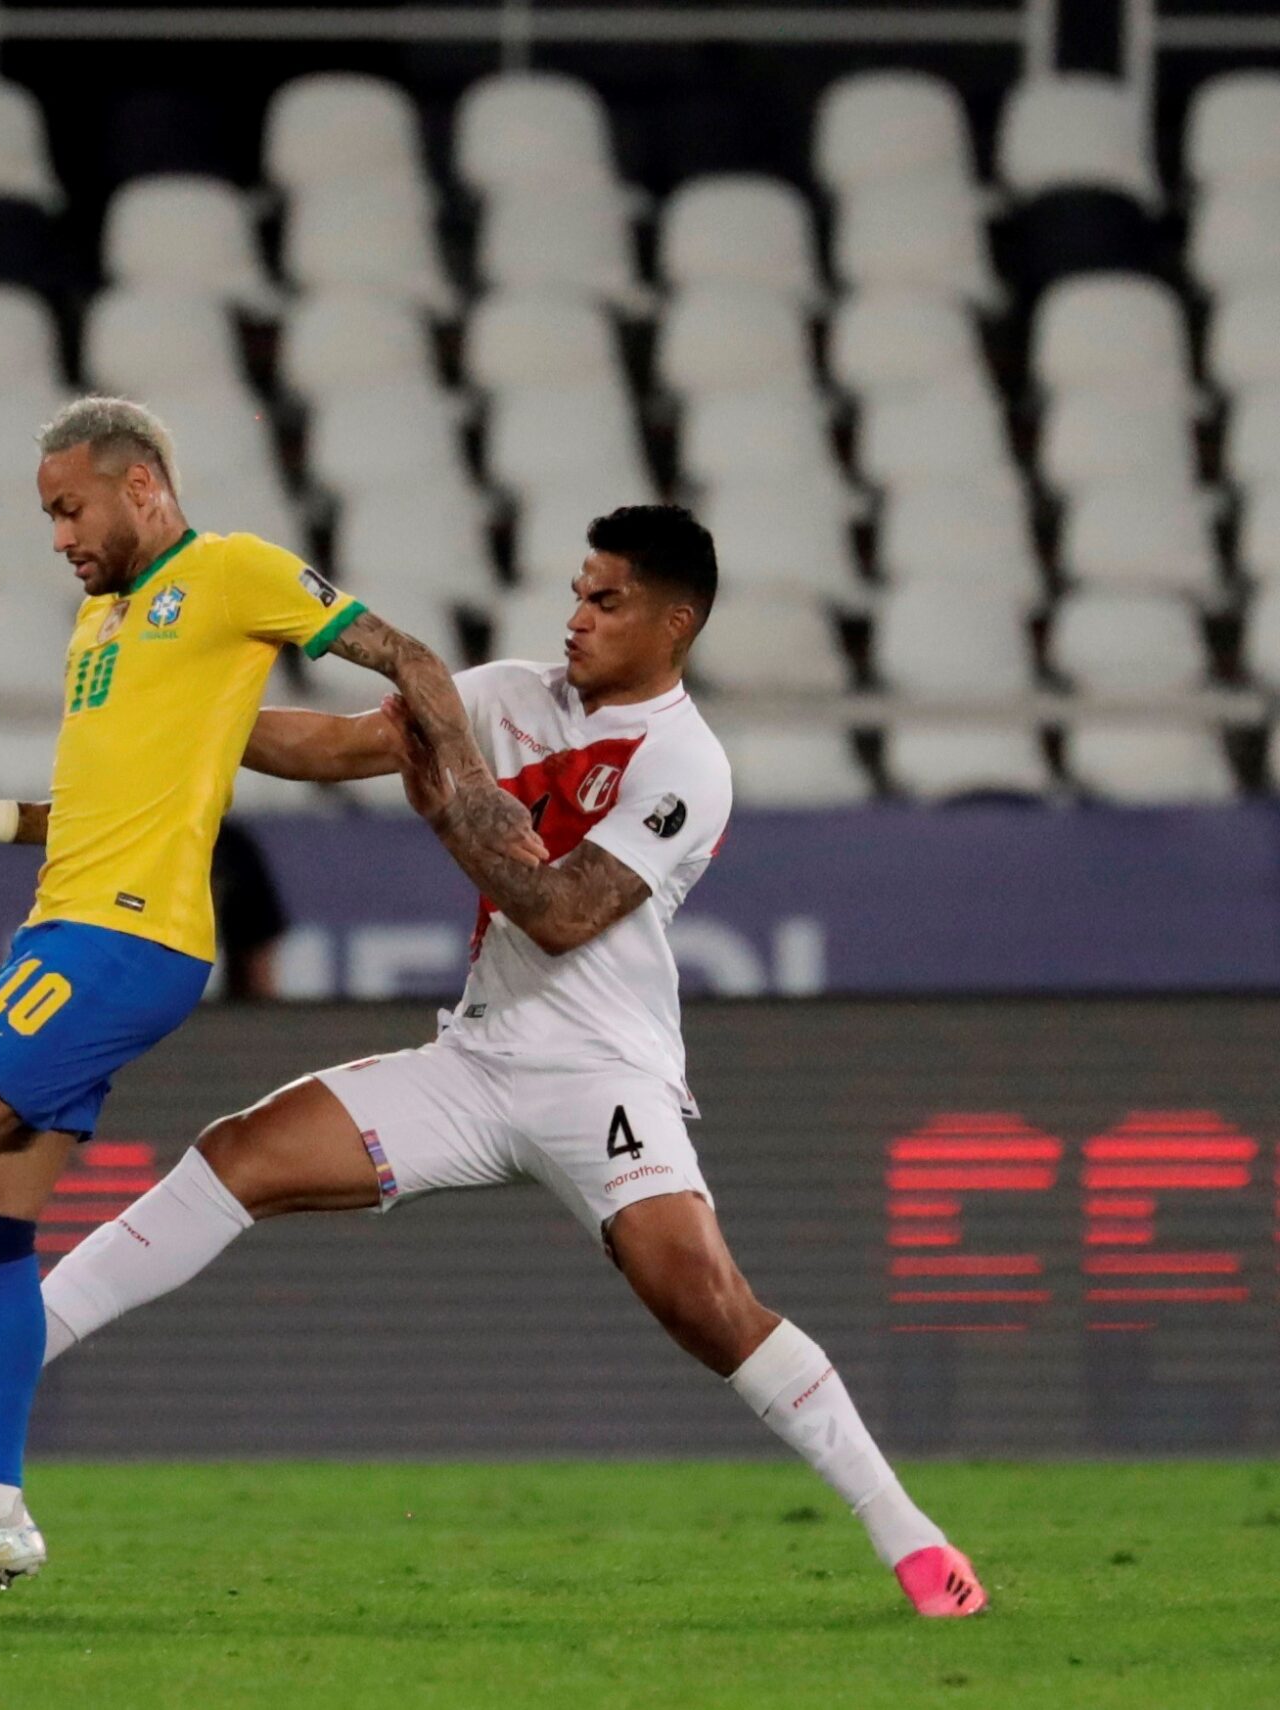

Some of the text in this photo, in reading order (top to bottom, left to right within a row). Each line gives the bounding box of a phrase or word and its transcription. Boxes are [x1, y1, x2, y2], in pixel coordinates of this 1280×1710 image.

[70, 641, 119, 713] 10
[606, 1104, 644, 1160] 4
[603, 1164, 674, 1195] marathon
